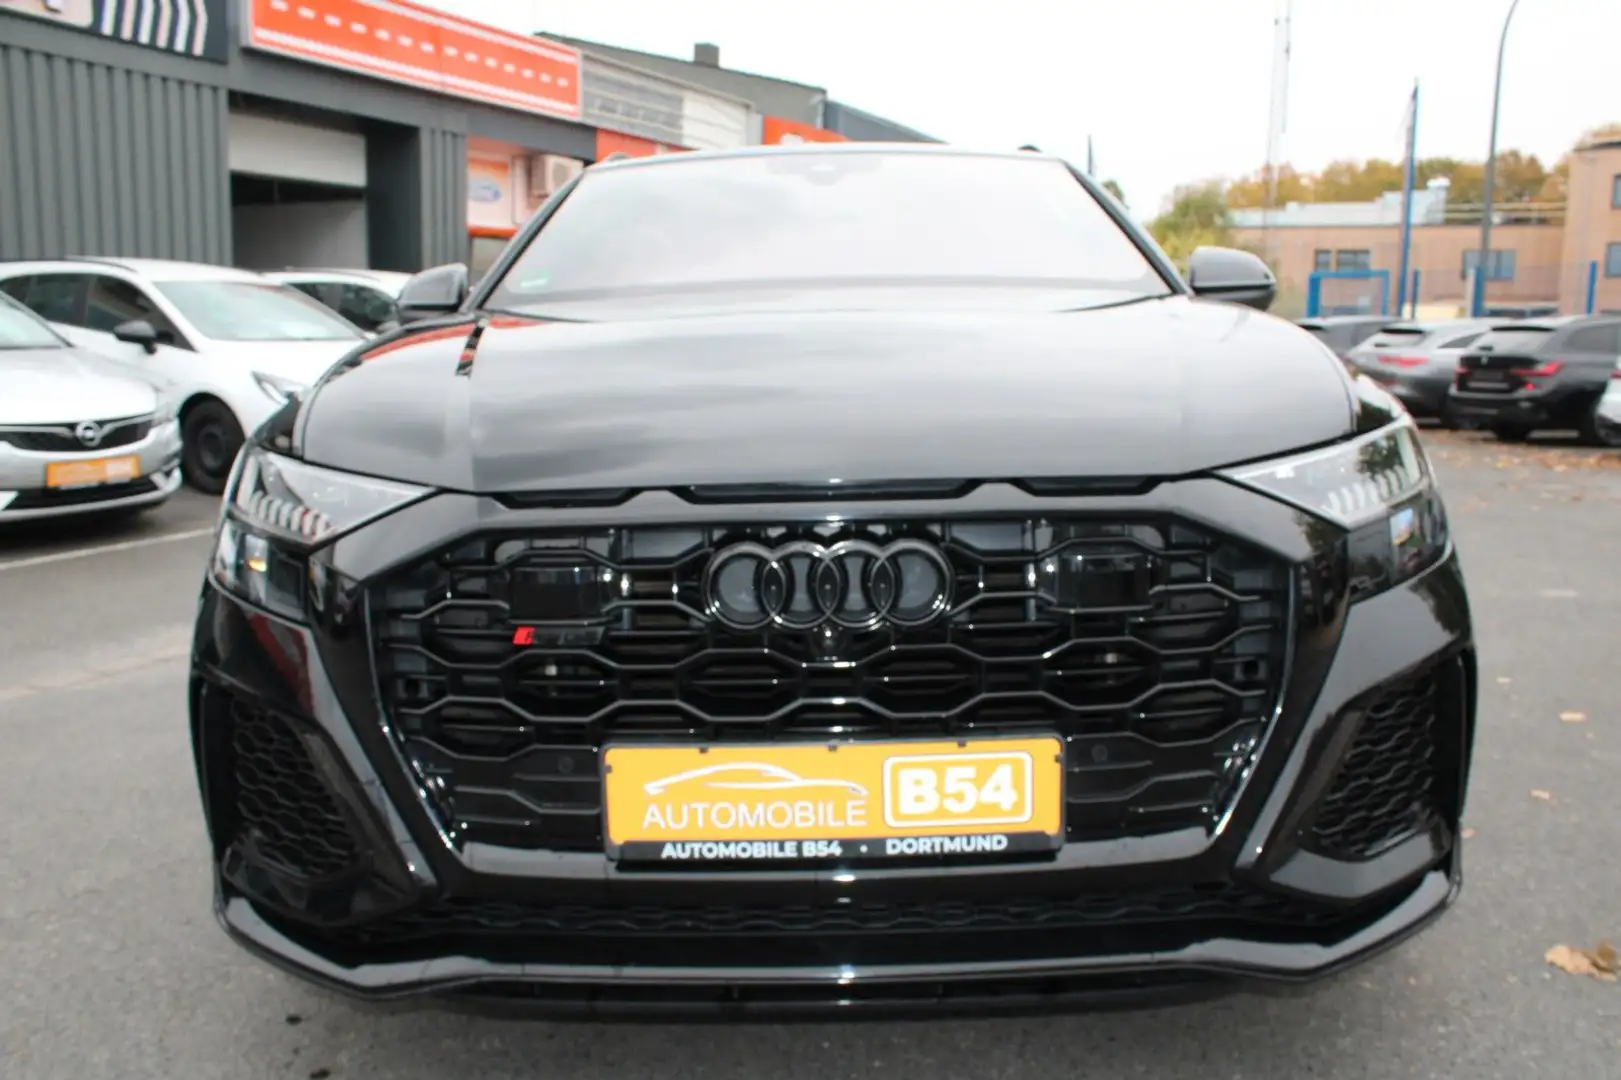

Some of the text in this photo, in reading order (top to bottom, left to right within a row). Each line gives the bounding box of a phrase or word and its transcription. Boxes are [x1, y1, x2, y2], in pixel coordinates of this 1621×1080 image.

[898, 764, 1018, 815] B54
[642, 800, 868, 830] AUTOMOBILE
[660, 834, 1008, 859] AUTOMOBILE B54 DORTMUND
